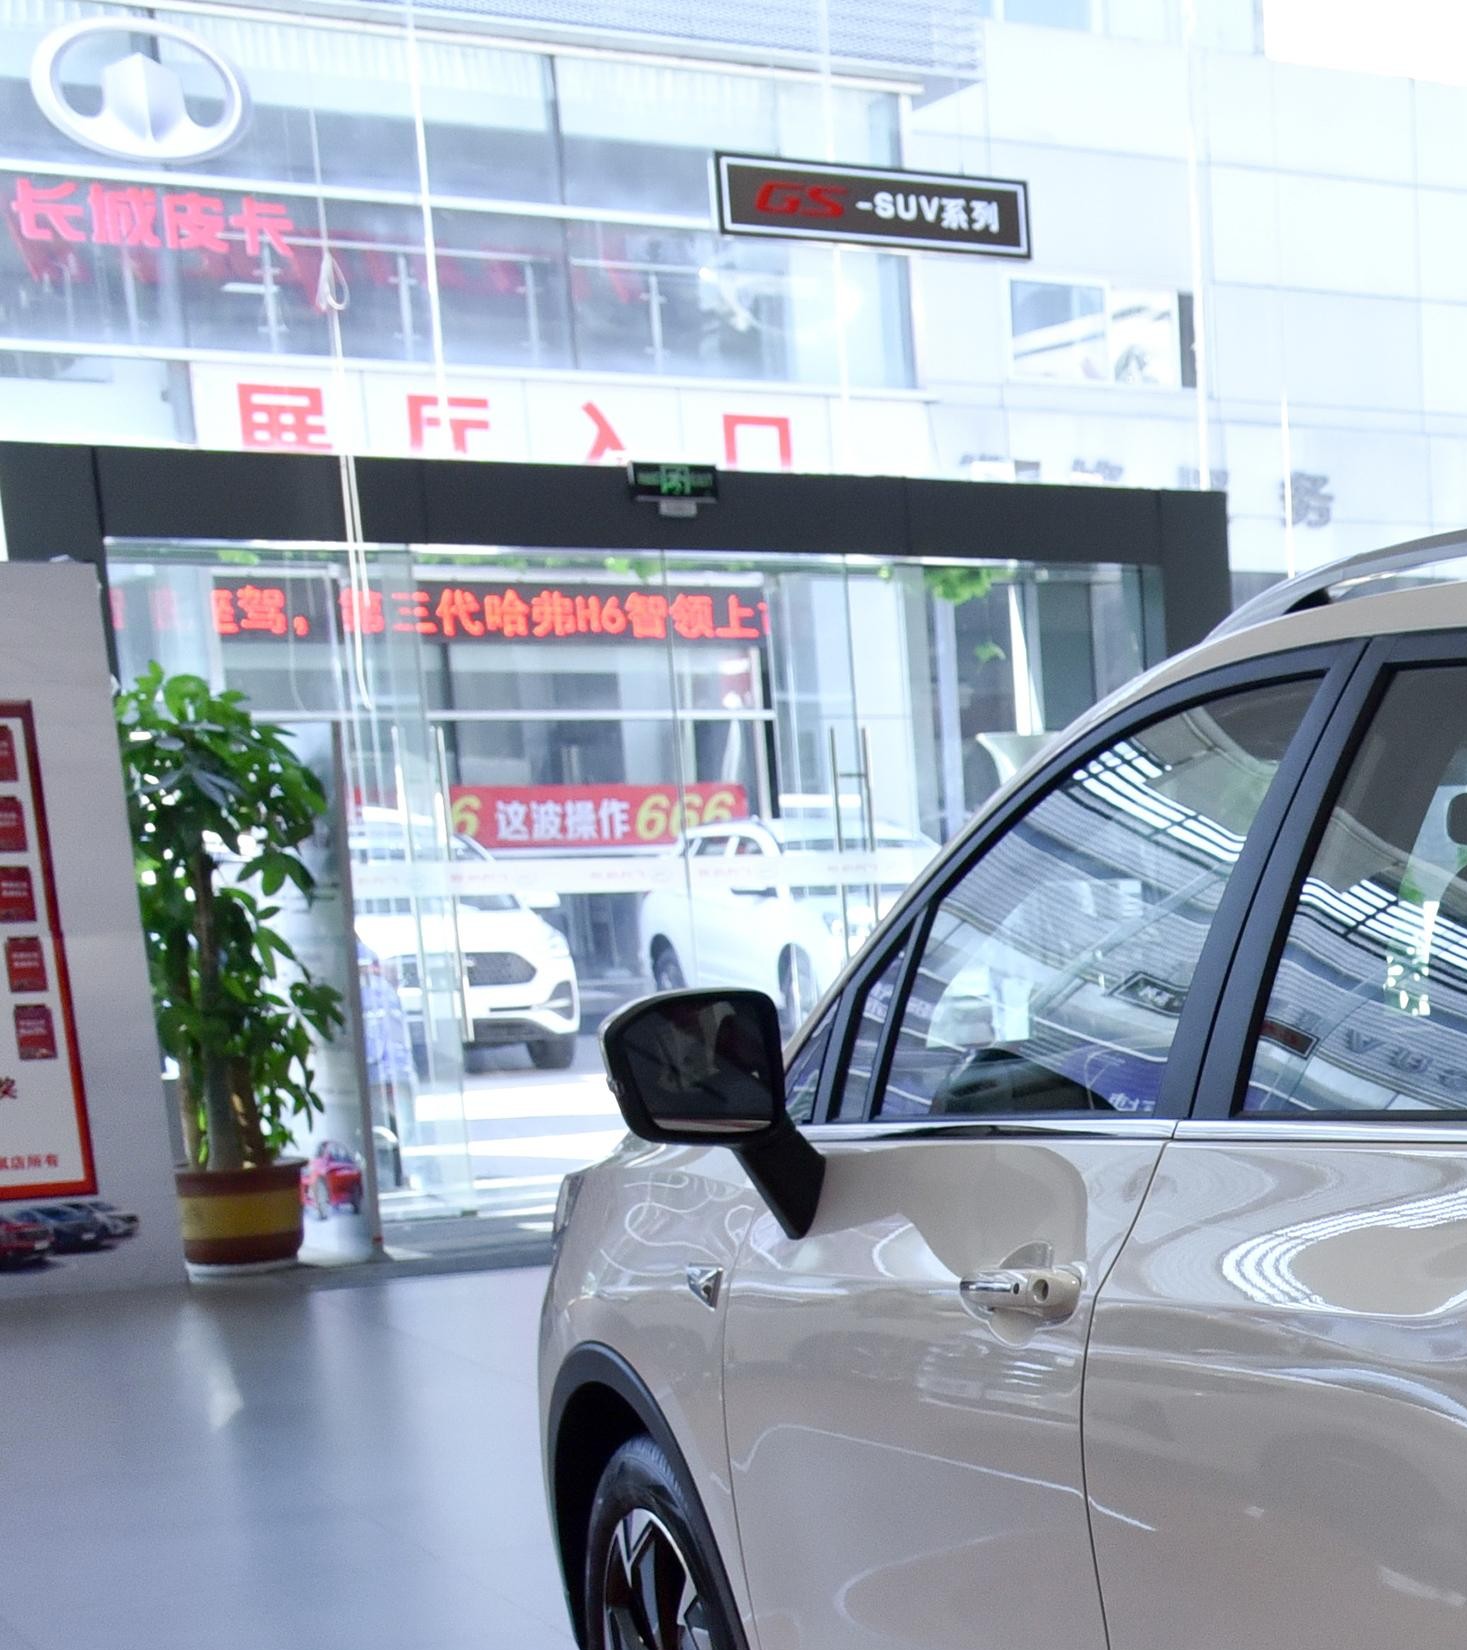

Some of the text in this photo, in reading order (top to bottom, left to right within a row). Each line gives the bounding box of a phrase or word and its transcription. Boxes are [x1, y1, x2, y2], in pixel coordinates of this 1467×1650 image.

[12, 178, 294, 257] 长城皮卡
[495, 799, 629, 842] 这波操作
